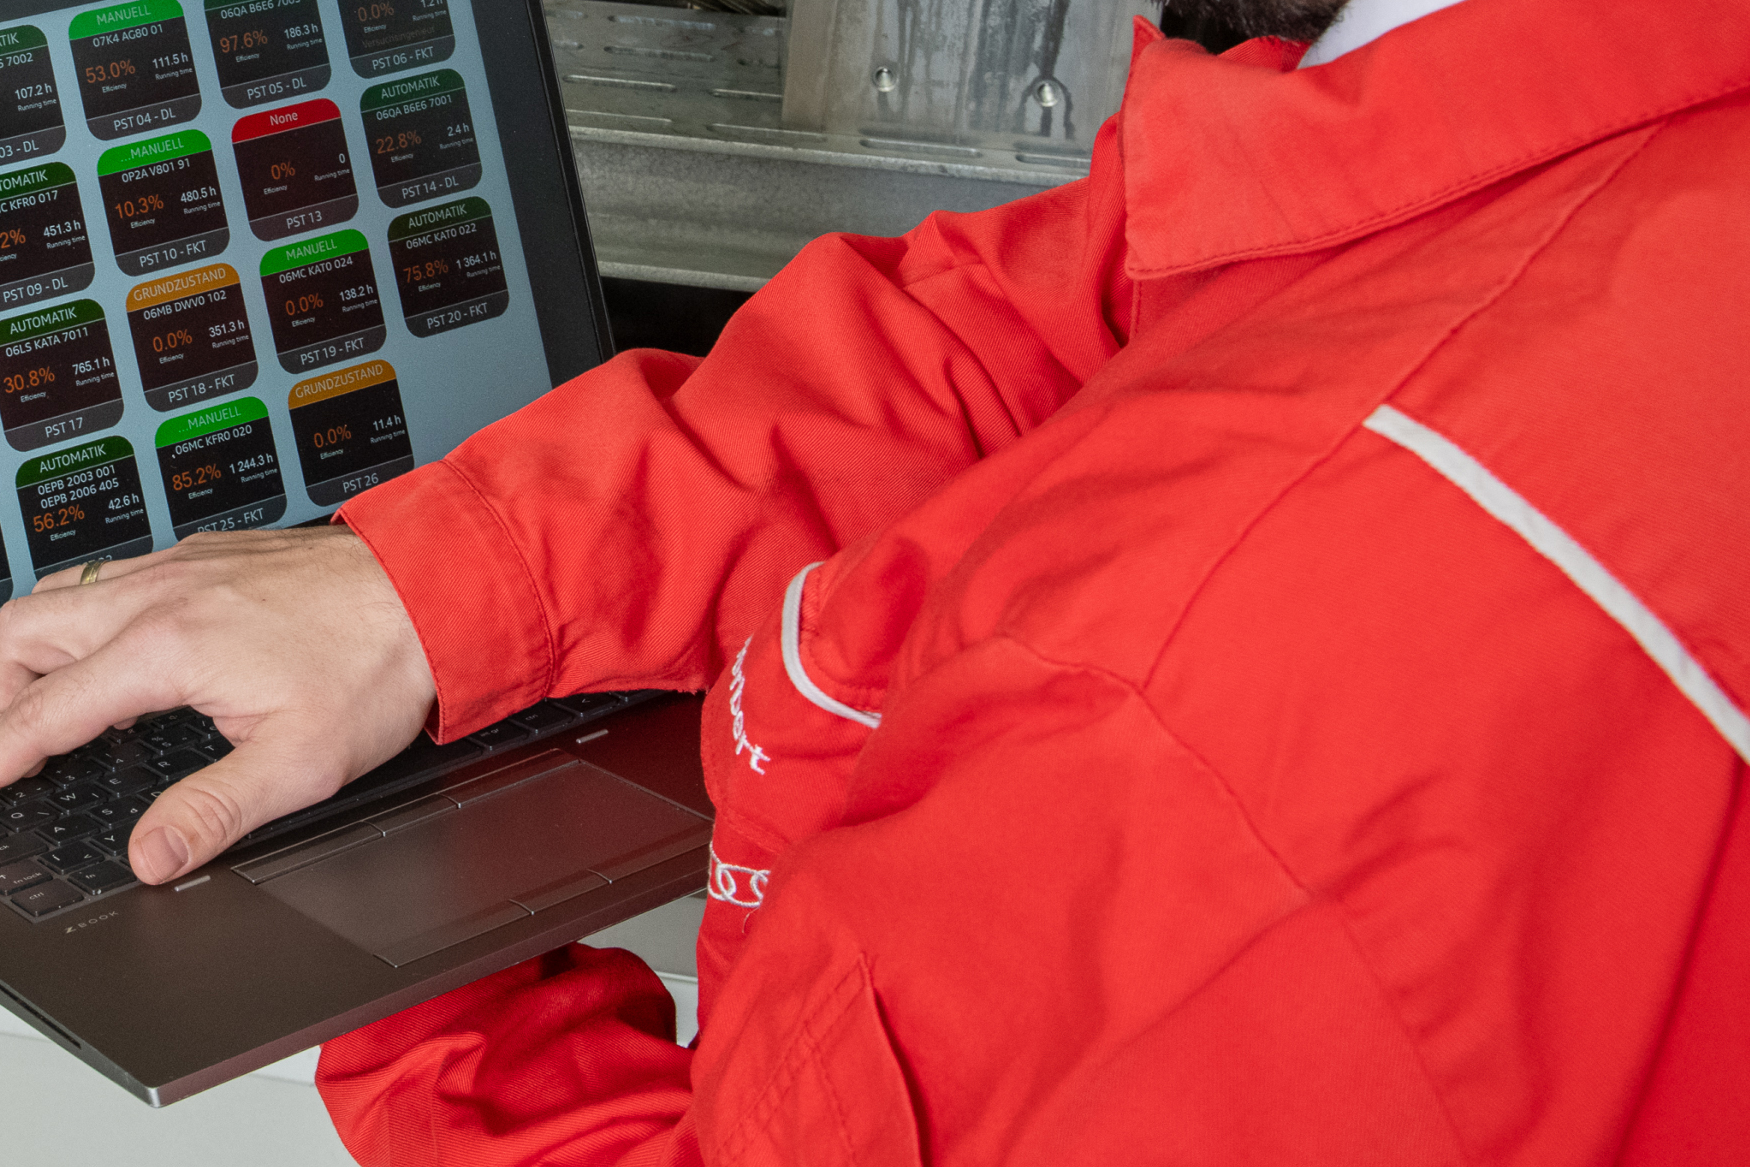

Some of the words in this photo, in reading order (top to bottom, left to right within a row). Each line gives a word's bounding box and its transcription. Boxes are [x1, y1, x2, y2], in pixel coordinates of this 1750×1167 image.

[96, 5, 150, 25] MANUELL
[357, 2, 394, 22] 0.0%
[219, 29, 268, 53] 97.6%
[85, 60, 135, 83] 53.0%
[246, 84, 266, 100] PST
[268, 81, 283, 94] 05
[291, 76, 307, 89] DL
[381, 75, 440, 99] AUTOMATIK
[17, 102, 43, 111] Running
[42, 98, 57, 106] time
[269, 111, 298, 126] None
[376, 131, 421, 154] 22.8%
[270, 161, 295, 180] 0%
[115, 194, 164, 218] 10.3%
[408, 203, 467, 229] AUTOMATIK
[286, 213, 306, 229] PST
[308, 210, 322, 223] 13
[139, 251, 159, 267] PST
[162, 247, 177, 261] 10
[185, 239, 206, 255] FKT
[285, 239, 337, 260] MANUELL
[403, 259, 448, 283] 75.8%
[133, 267, 226, 301] GRUNDZUSTAND
[285, 293, 323, 316] 0.0%
[10, 306, 77, 334] AUTOMATIK
[152, 329, 193, 352] 0.0%
[72, 358, 100, 375] 765.1
[101, 356, 110, 367] h
[3, 366, 55, 393] 30.8%
[295, 364, 383, 398] GRUNDZUSTAND
[44, 421, 66, 438] PST
[68, 416, 83, 430] 17
[313, 424, 352, 448] 0.0%
[39, 443, 106, 473] AUTOMATIK
[172, 464, 221, 491] 85.2%
[342, 477, 361, 493] PST
[364, 472, 379, 486] 26
[33, 504, 85, 532] 56.2%
[22, 871, 43, 884] lock
[28, 890, 45, 901] ctrl
